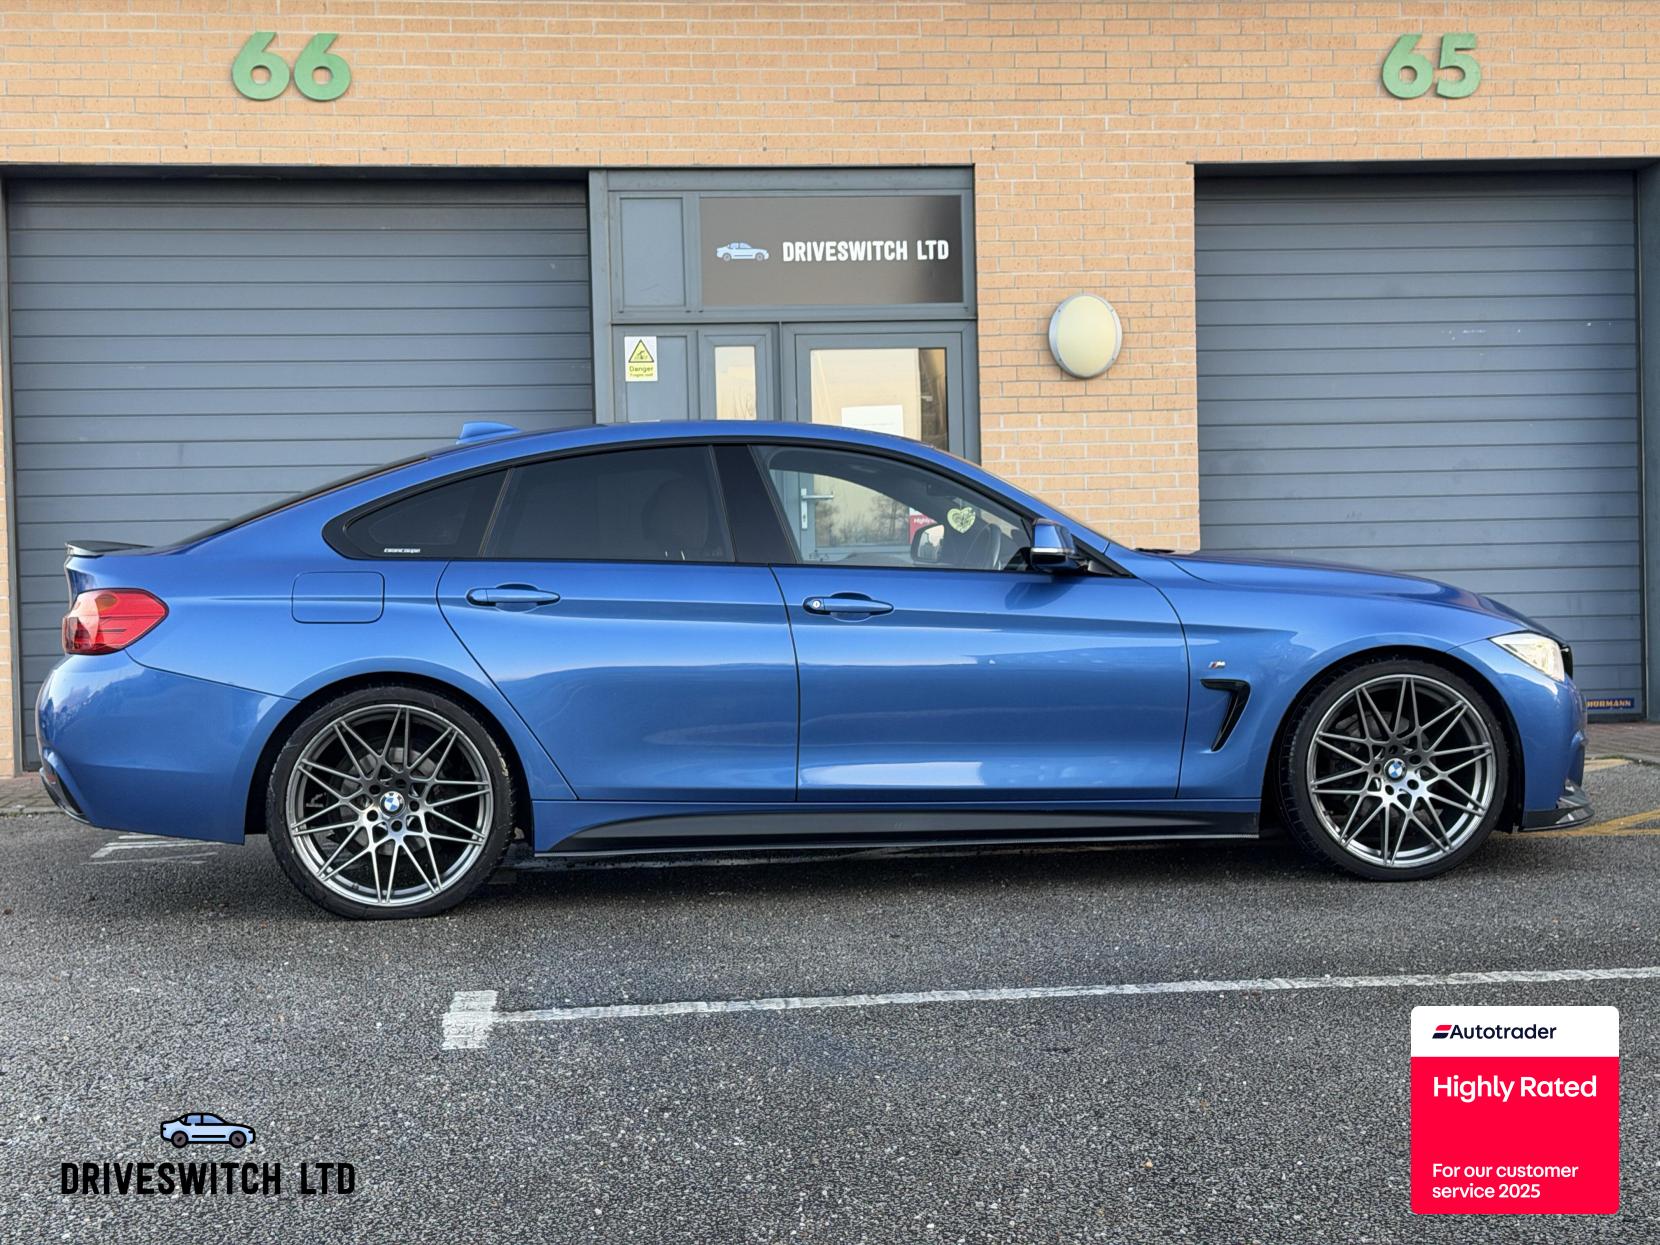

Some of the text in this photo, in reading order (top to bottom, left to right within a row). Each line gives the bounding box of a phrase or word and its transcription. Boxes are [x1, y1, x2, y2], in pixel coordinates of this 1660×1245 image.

[231, 31, 352, 102] 66
[1381, 32, 1481, 100] 65
[782, 240, 949, 262] DRIVESWITCH LTD
